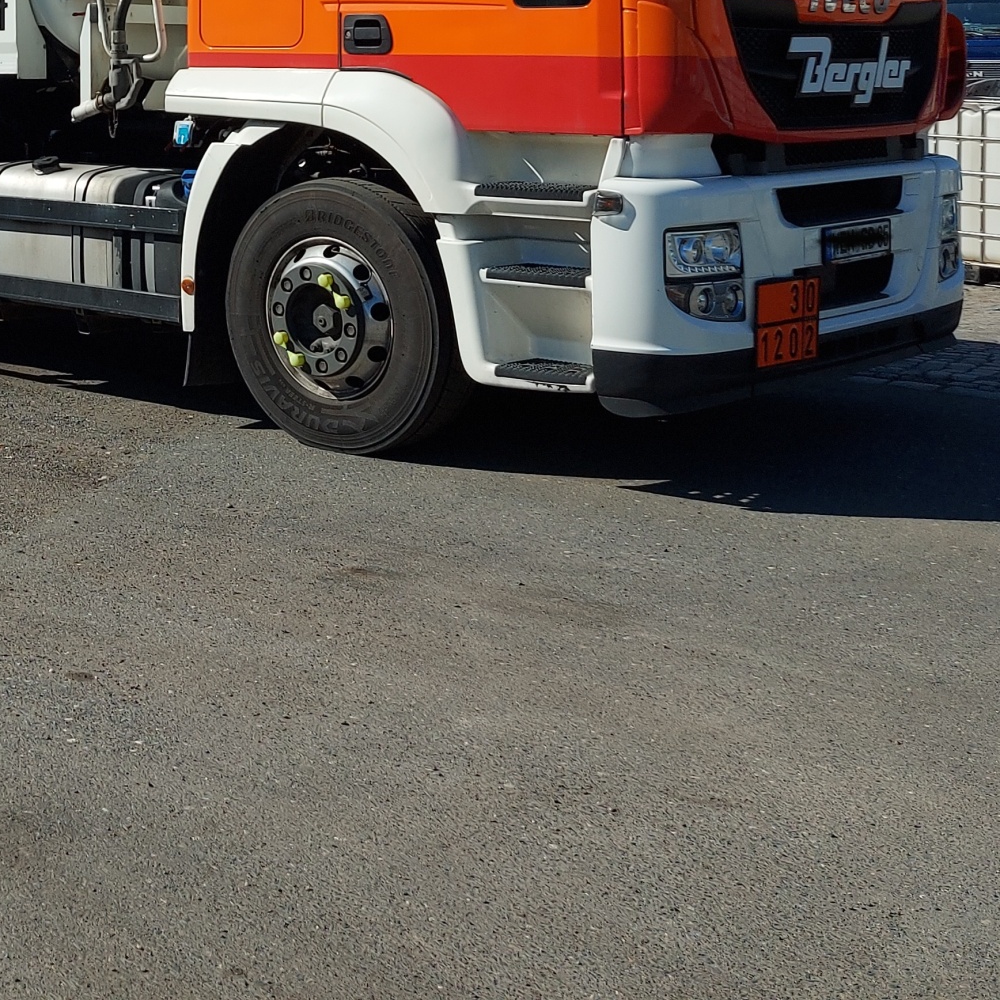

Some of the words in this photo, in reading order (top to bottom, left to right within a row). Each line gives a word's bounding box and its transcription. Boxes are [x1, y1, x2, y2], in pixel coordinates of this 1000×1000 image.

[788, 36, 911, 104] Bergler
[305, 209, 398, 277] BRIDGESTONE
[790, 281, 815, 314] 30
[761, 325, 815, 362] 1202
